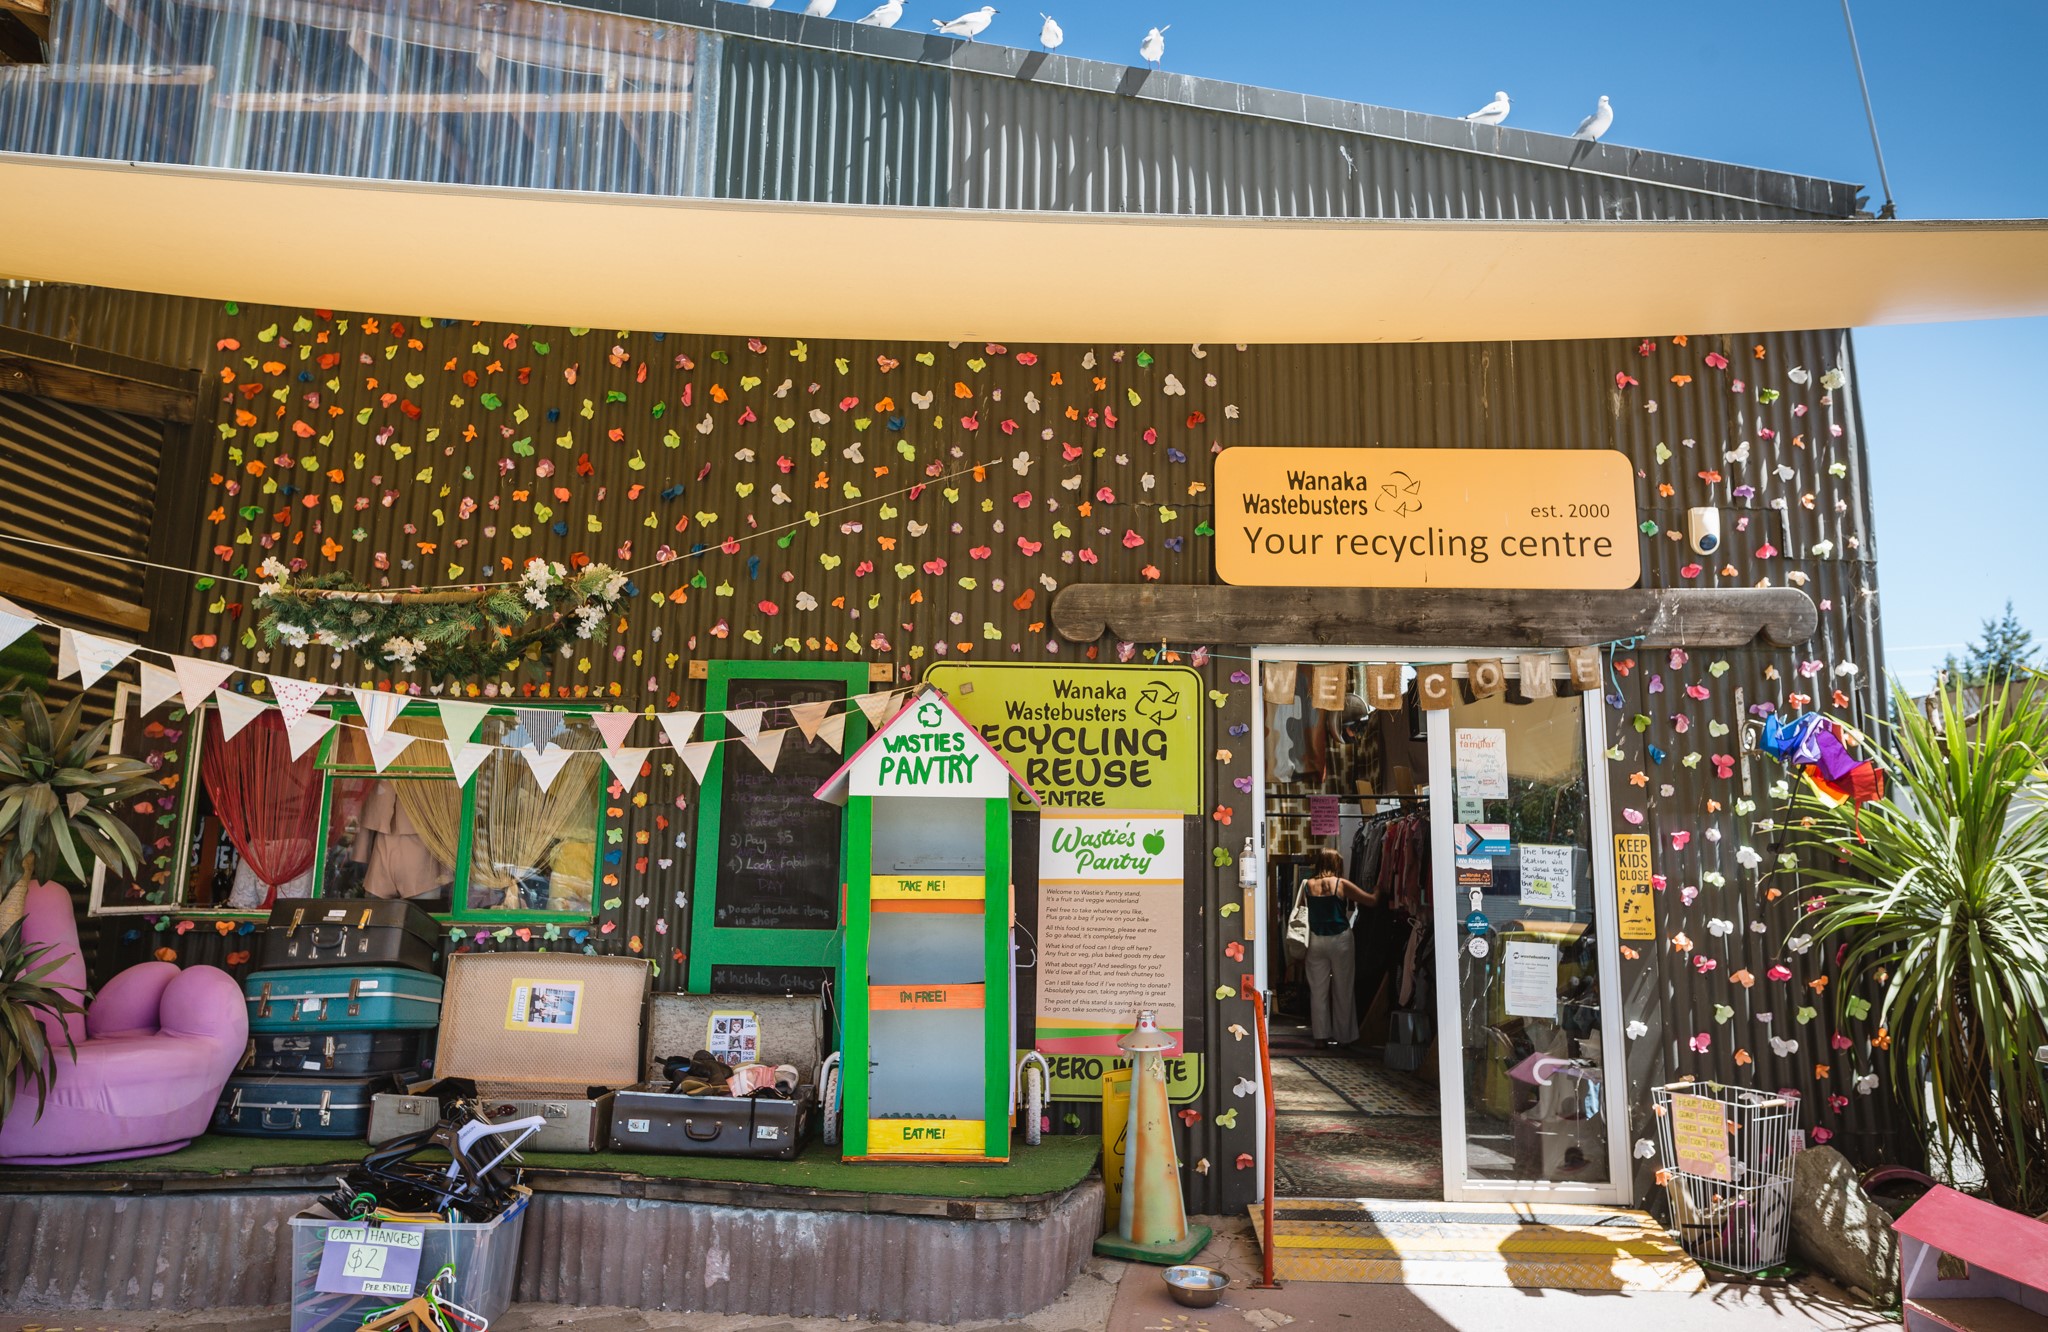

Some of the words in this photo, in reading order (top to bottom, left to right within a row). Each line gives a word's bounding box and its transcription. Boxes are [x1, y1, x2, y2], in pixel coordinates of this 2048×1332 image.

[1287, 470, 1367, 491] Wanaka
[1242, 493, 1368, 515] Wastebusters
[1530, 505, 1563, 518] est.
[1568, 504, 1610, 518] 2000
[1243, 526, 1324, 555] Your
[1336, 527, 1489, 564] recycling
[1500, 532, 1612, 557] centre
[1266, 658, 1597, 700] WELCOME
[1053, 679, 1127, 700] Wanaka
[1005, 700, 1127, 722] Wastebusters
[882, 732, 966, 753] WASTIES
[973, 723, 1168, 761] ECYCLING
[878, 753, 979, 786] PANTRY
[1026, 757, 1152, 788] REUSE
[745, 834, 767, 854] Pay
[777, 830, 794, 844] $5
[1051, 821, 1136, 853] Wastie's
[1522, 847, 1537, 855] The
[1618, 839, 1647, 853] KEEP
[746, 857, 776, 870] Look
[1075, 848, 1152, 875] Pantry
[1522, 864, 1529, 872] be
[1619, 853, 1648, 868] KIDS
[1619, 869, 1649, 881] CLOSE
[897, 880, 921, 892] TAKE
[926, 880, 946, 892] ME!
[1092, 933, 1124, 941] completely
[1112, 944, 1126, 952] drop
[1079, 962, 1096, 970] eggs?
[1148, 963, 1162, 971] you?
[914, 990, 947, 1003] FREE!
[1044, 987, 1074, 995] Absolutely
[1100, 988, 1118, 996] taking
[1151, 989, 1166, 997] great
[903, 1127, 925, 1140] EAT
[925, 1128, 946, 1140] ME!
[330, 1228, 364, 1241] COAT
[370, 1230, 420, 1247] HANGERS
[347, 1247, 380, 1273] $2
[364, 1282, 380, 1291] PER
